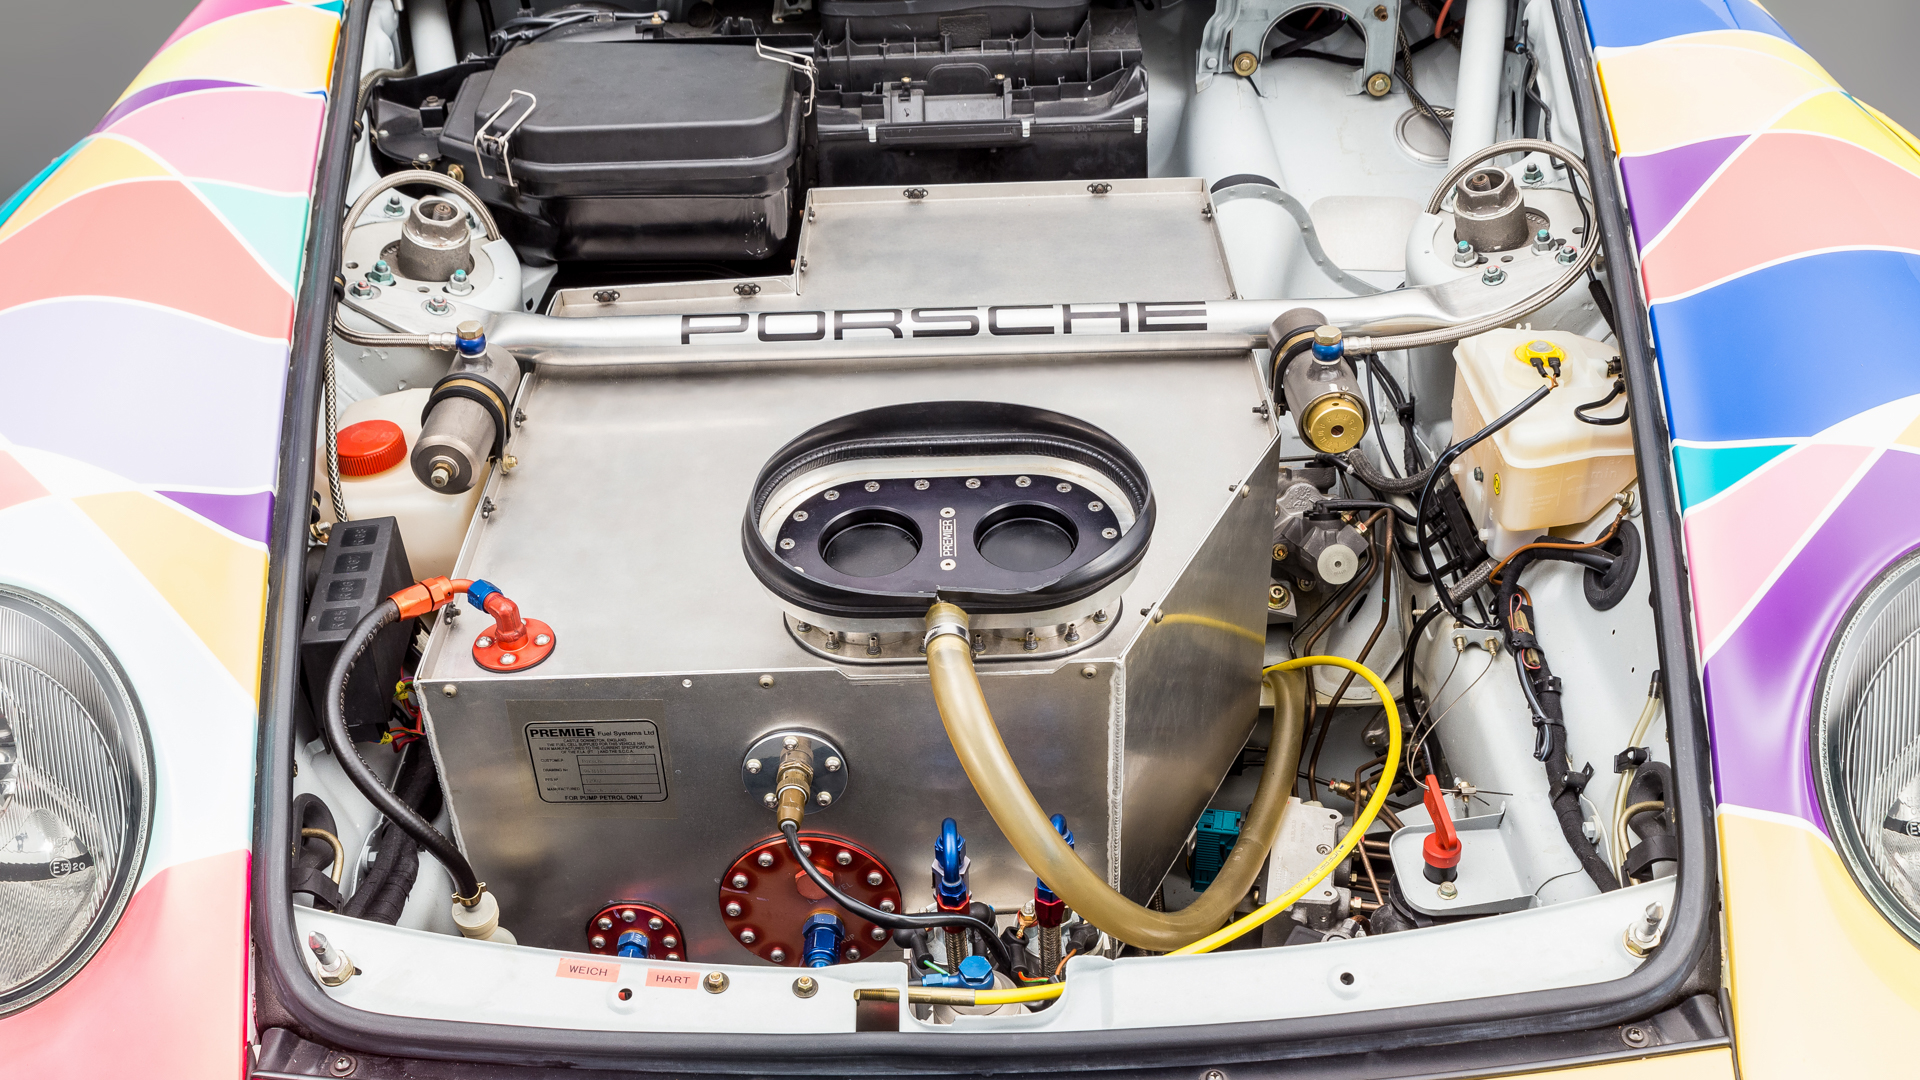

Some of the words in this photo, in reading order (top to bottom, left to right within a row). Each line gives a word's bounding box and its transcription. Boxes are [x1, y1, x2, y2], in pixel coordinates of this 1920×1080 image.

[681, 301, 1207, 344] PORSCHE
[942, 520, 953, 556] PREMIER
[530, 728, 595, 738] PREMIER
[72, 862, 86, 871] 20
[569, 965, 608, 976] WEICH
[656, 975, 691, 984] HART
